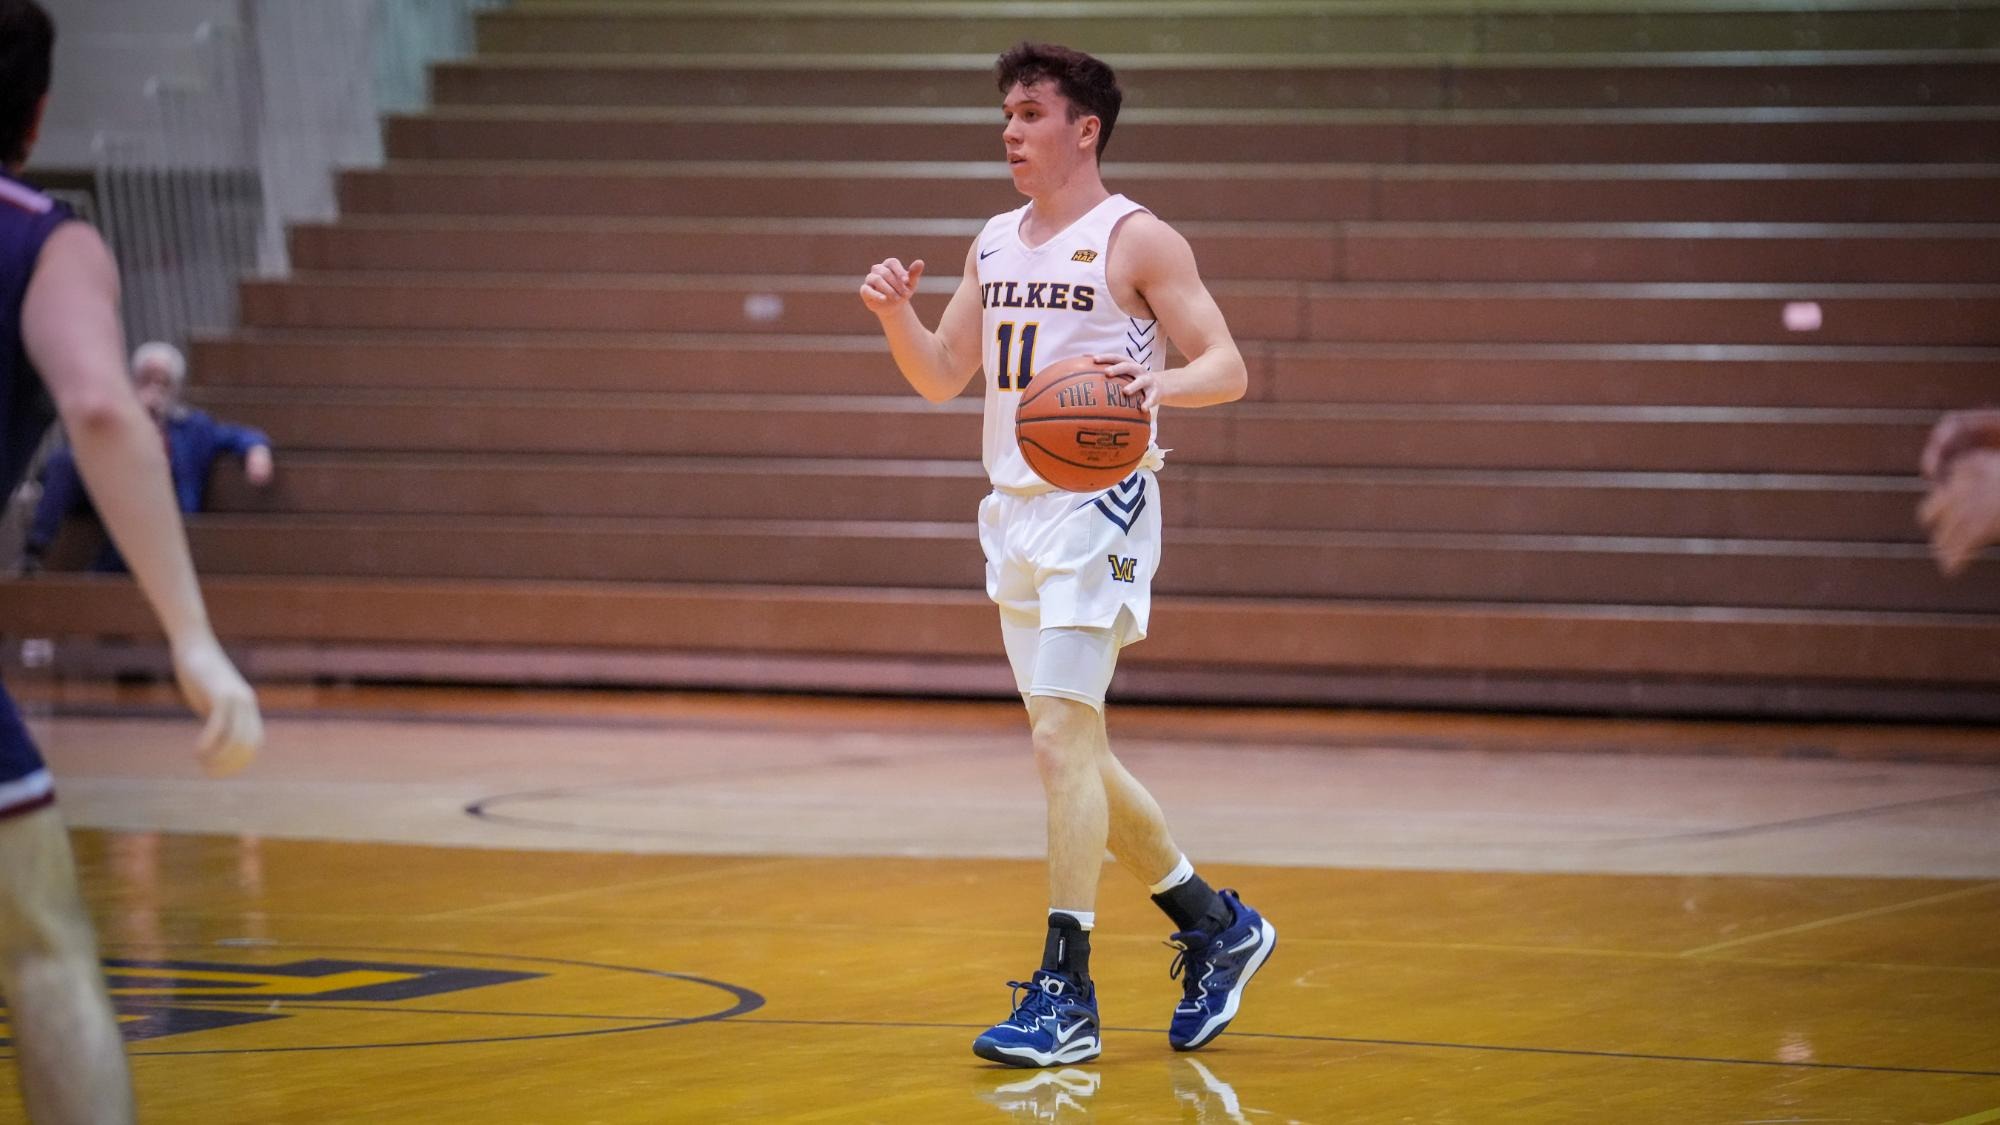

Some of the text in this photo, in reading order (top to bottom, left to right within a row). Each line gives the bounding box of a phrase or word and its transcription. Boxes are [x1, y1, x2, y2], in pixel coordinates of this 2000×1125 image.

[996, 321, 1040, 392] 11
[1056, 382, 1097, 408] THE
[1107, 554, 1138, 584] W
